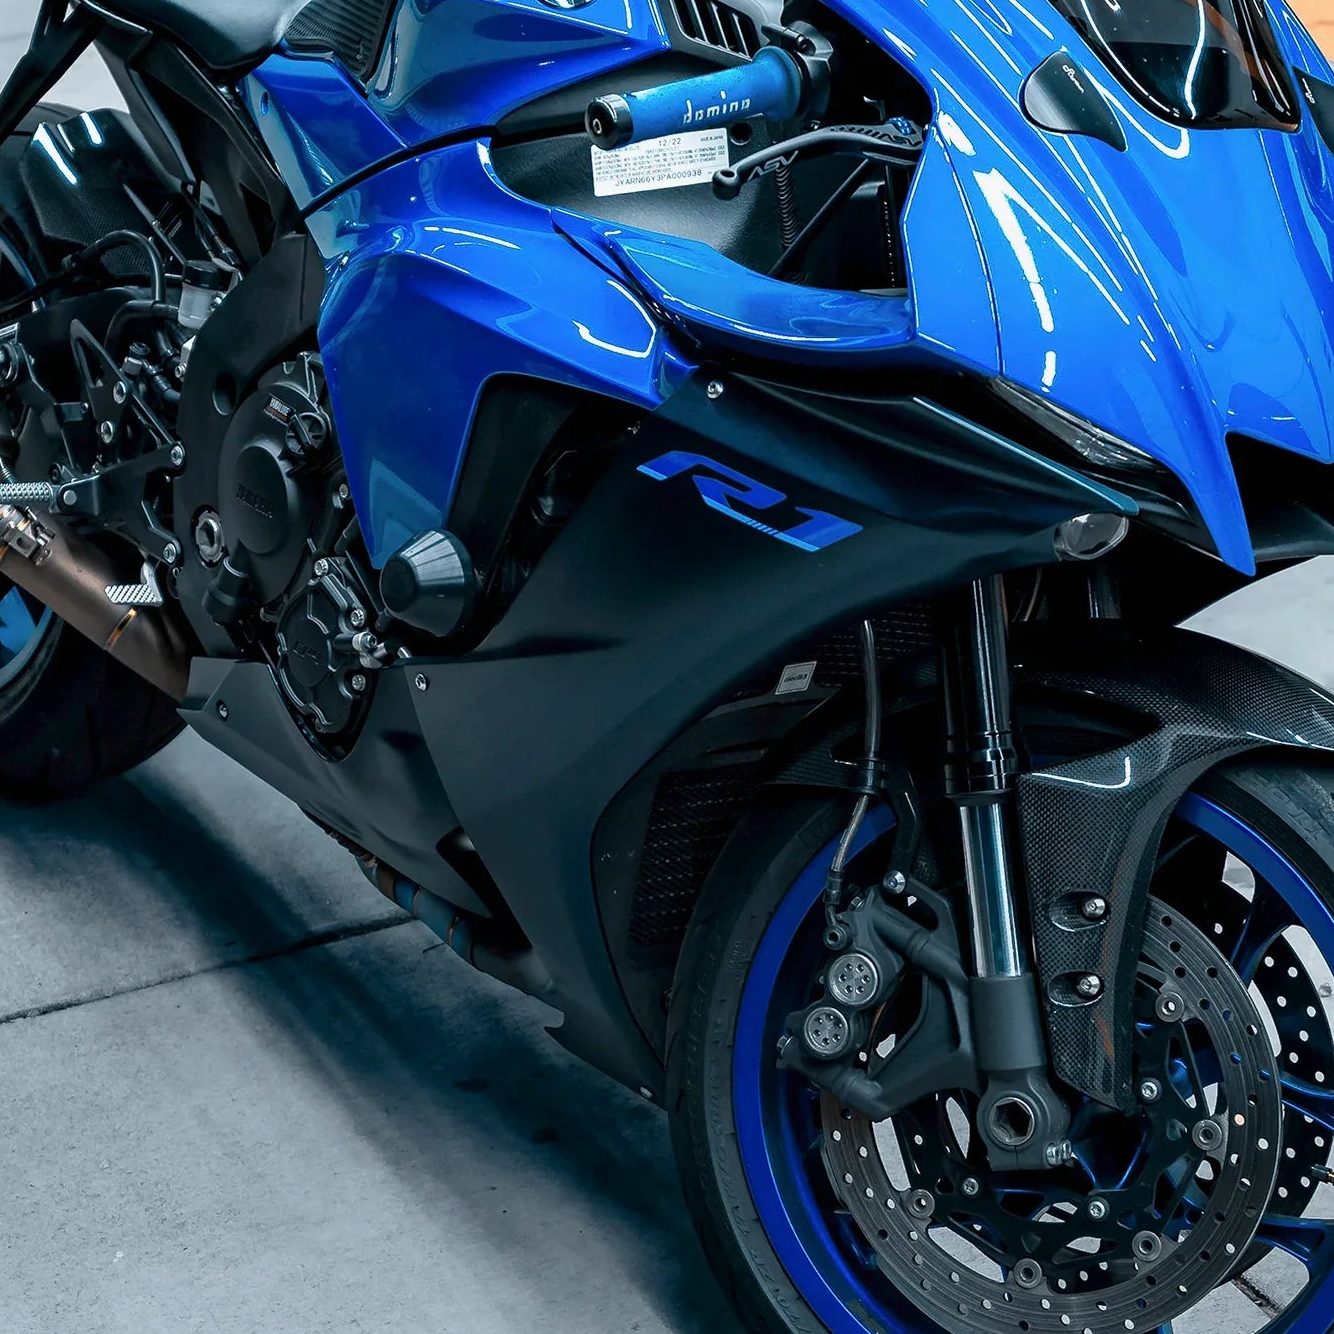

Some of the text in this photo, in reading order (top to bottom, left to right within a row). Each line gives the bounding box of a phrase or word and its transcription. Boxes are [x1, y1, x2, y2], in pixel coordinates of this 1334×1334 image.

[683, 90, 751, 124] domino
[658, 137, 682, 147] 12/22
[636, 450, 864, 552] R1
